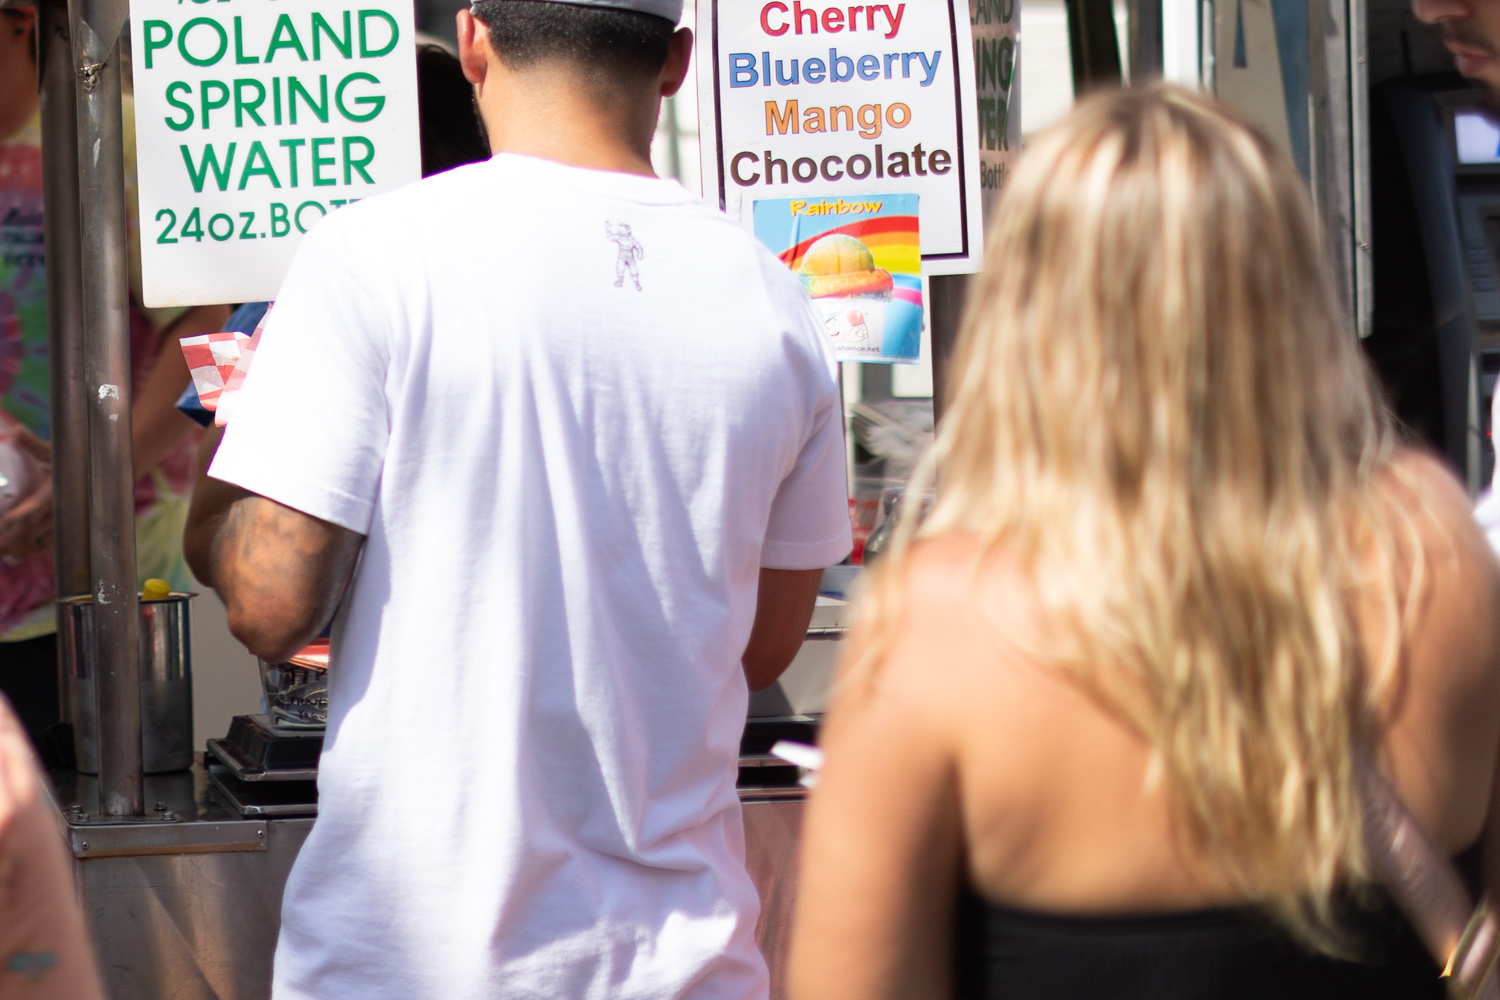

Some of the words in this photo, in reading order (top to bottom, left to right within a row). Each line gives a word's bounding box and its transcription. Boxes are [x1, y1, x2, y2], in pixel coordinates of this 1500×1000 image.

[143, 8, 400, 70] POLAND
[759, 0, 907, 40] Cherry
[729, 47, 942, 88] Blueberry
[975, 36, 1014, 92] ING
[163, 71, 387, 132] SPRING
[765, 99, 912, 139] Mango
[977, 98, 1010, 153] TER
[179, 135, 376, 194] WATER
[731, 143, 953, 187] Chocolate
[154, 197, 364, 245] 24oz.BO
[790, 199, 883, 217] Rainbow
